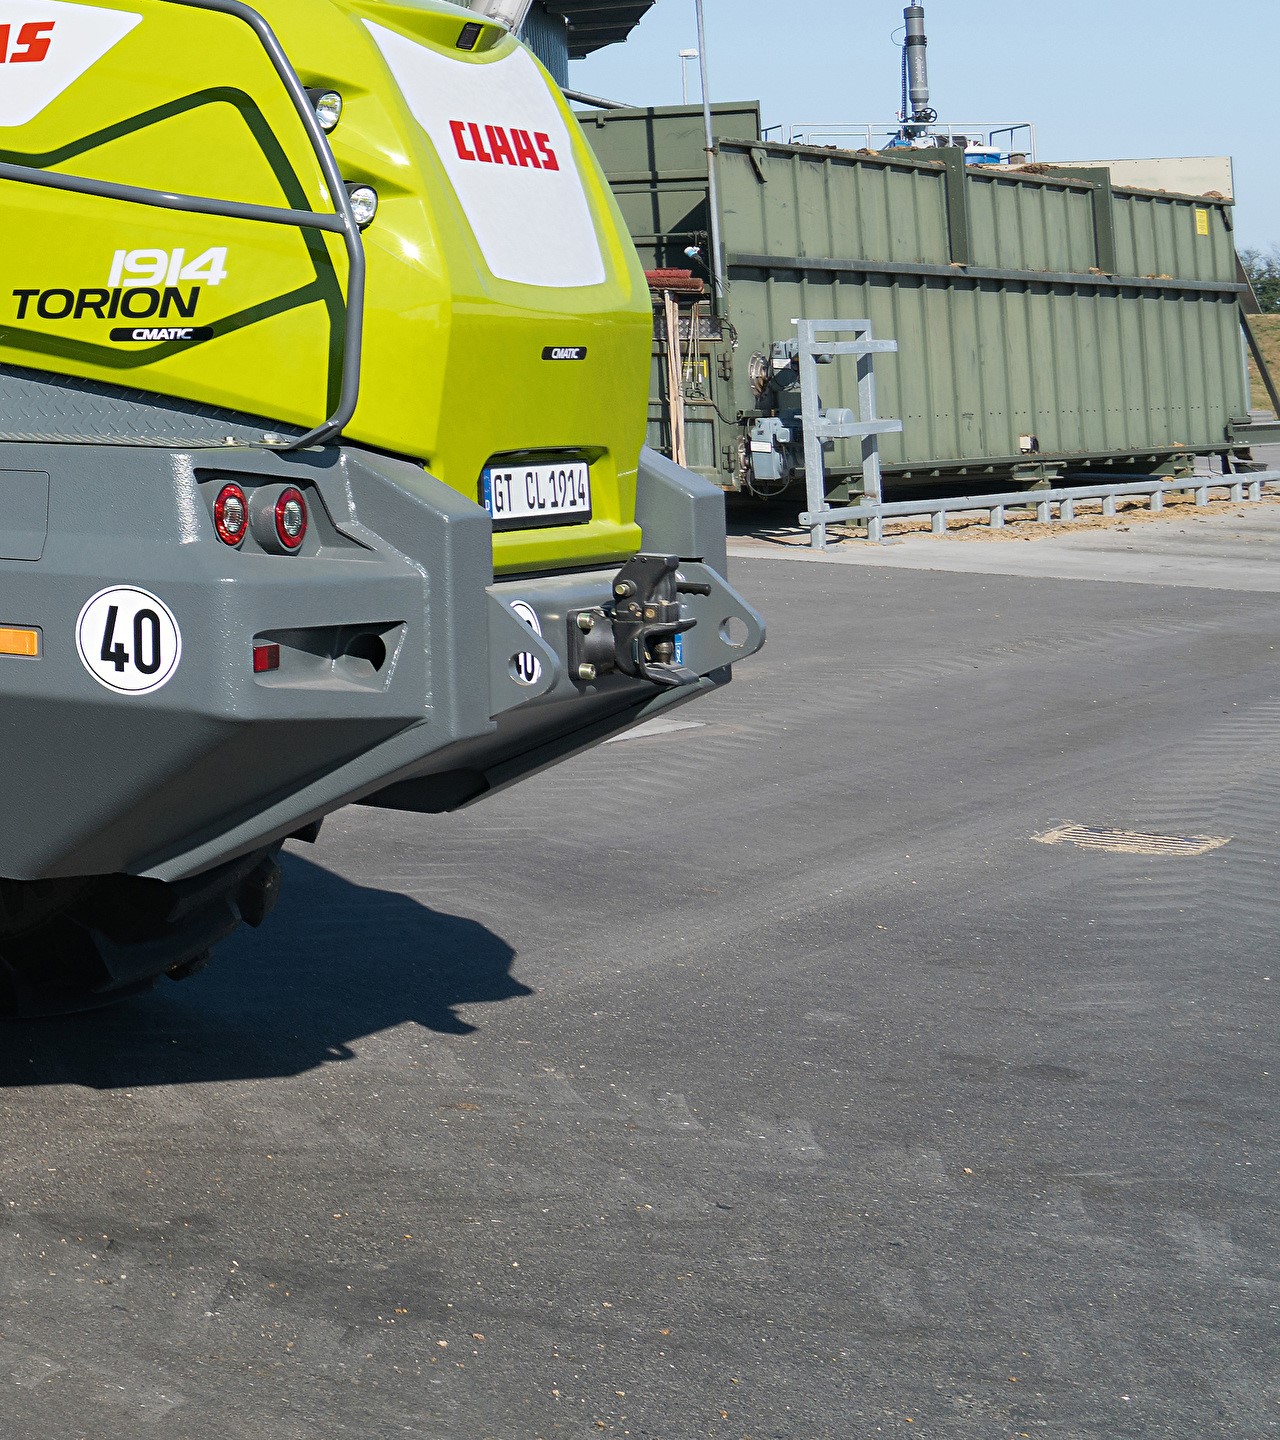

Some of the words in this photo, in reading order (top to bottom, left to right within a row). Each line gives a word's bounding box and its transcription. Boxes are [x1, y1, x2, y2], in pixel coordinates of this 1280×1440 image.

[449, 120, 560, 171] CLAAS
[107, 247, 228, 288] 1914
[12, 286, 201, 320] TORION
[132, 328, 194, 340] CMATIC
[551, 347, 581, 359] CMATIC
[493, 473, 512, 513] GT
[100, 605, 161, 675] 40
